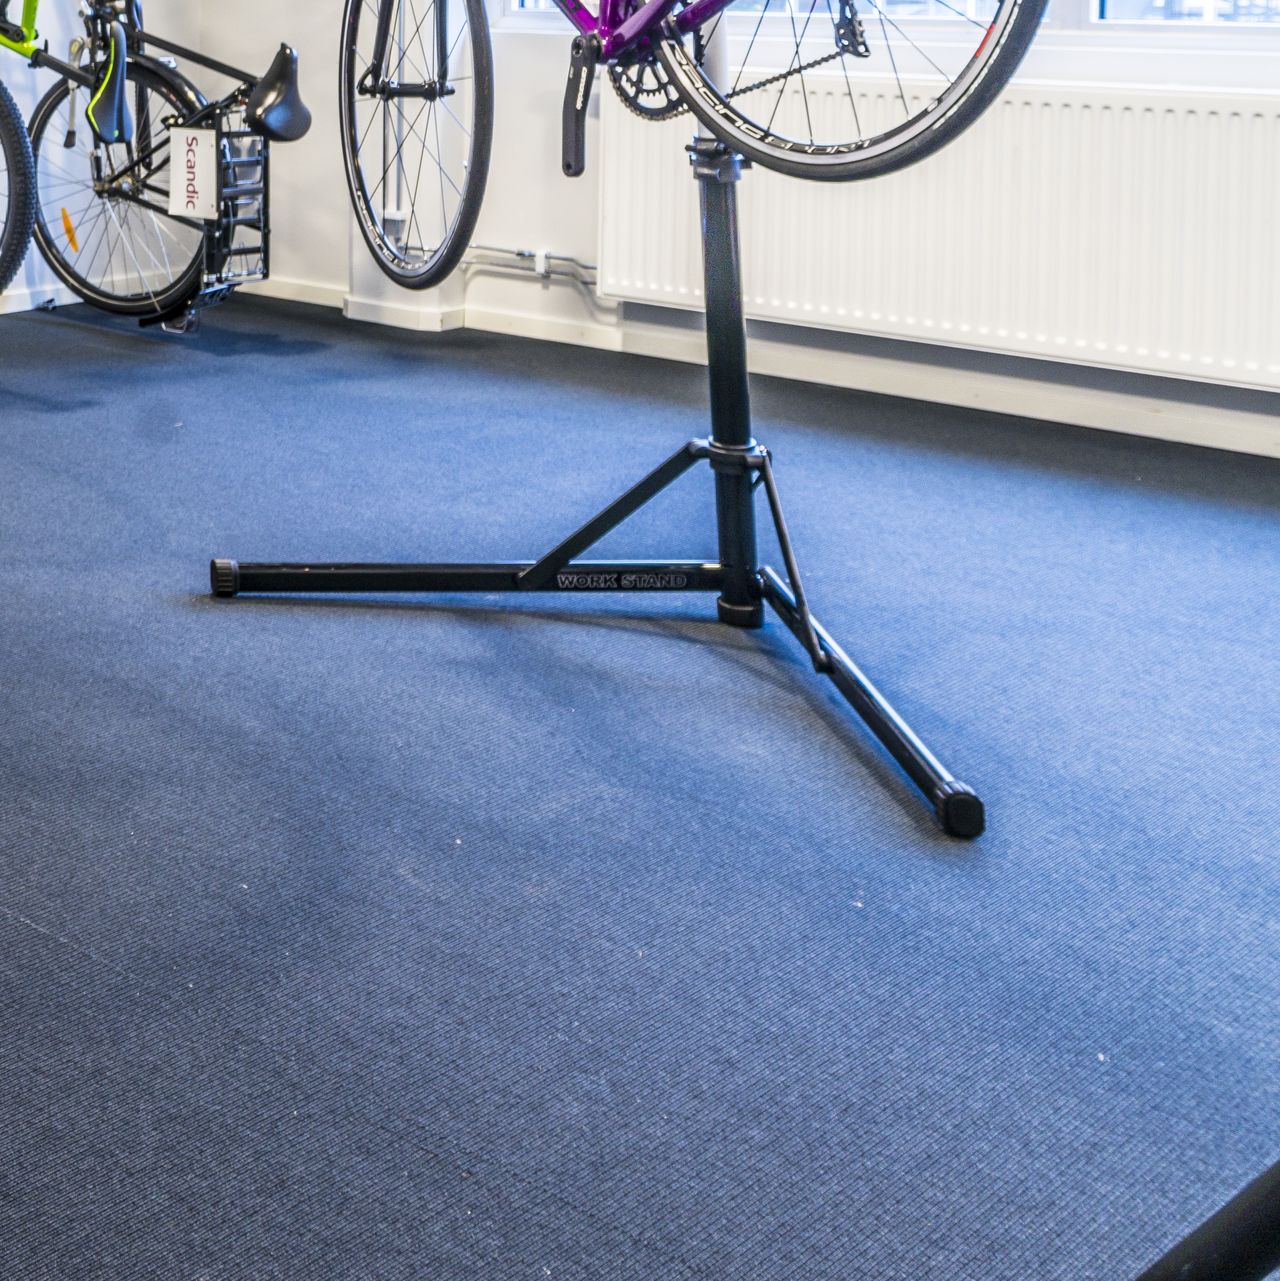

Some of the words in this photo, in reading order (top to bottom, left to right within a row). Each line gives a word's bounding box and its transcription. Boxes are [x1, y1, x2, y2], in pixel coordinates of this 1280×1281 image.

[185, 135, 199, 212] Scandic
[557, 574, 618, 588] WORK
[621, 574, 687, 588] STAND
